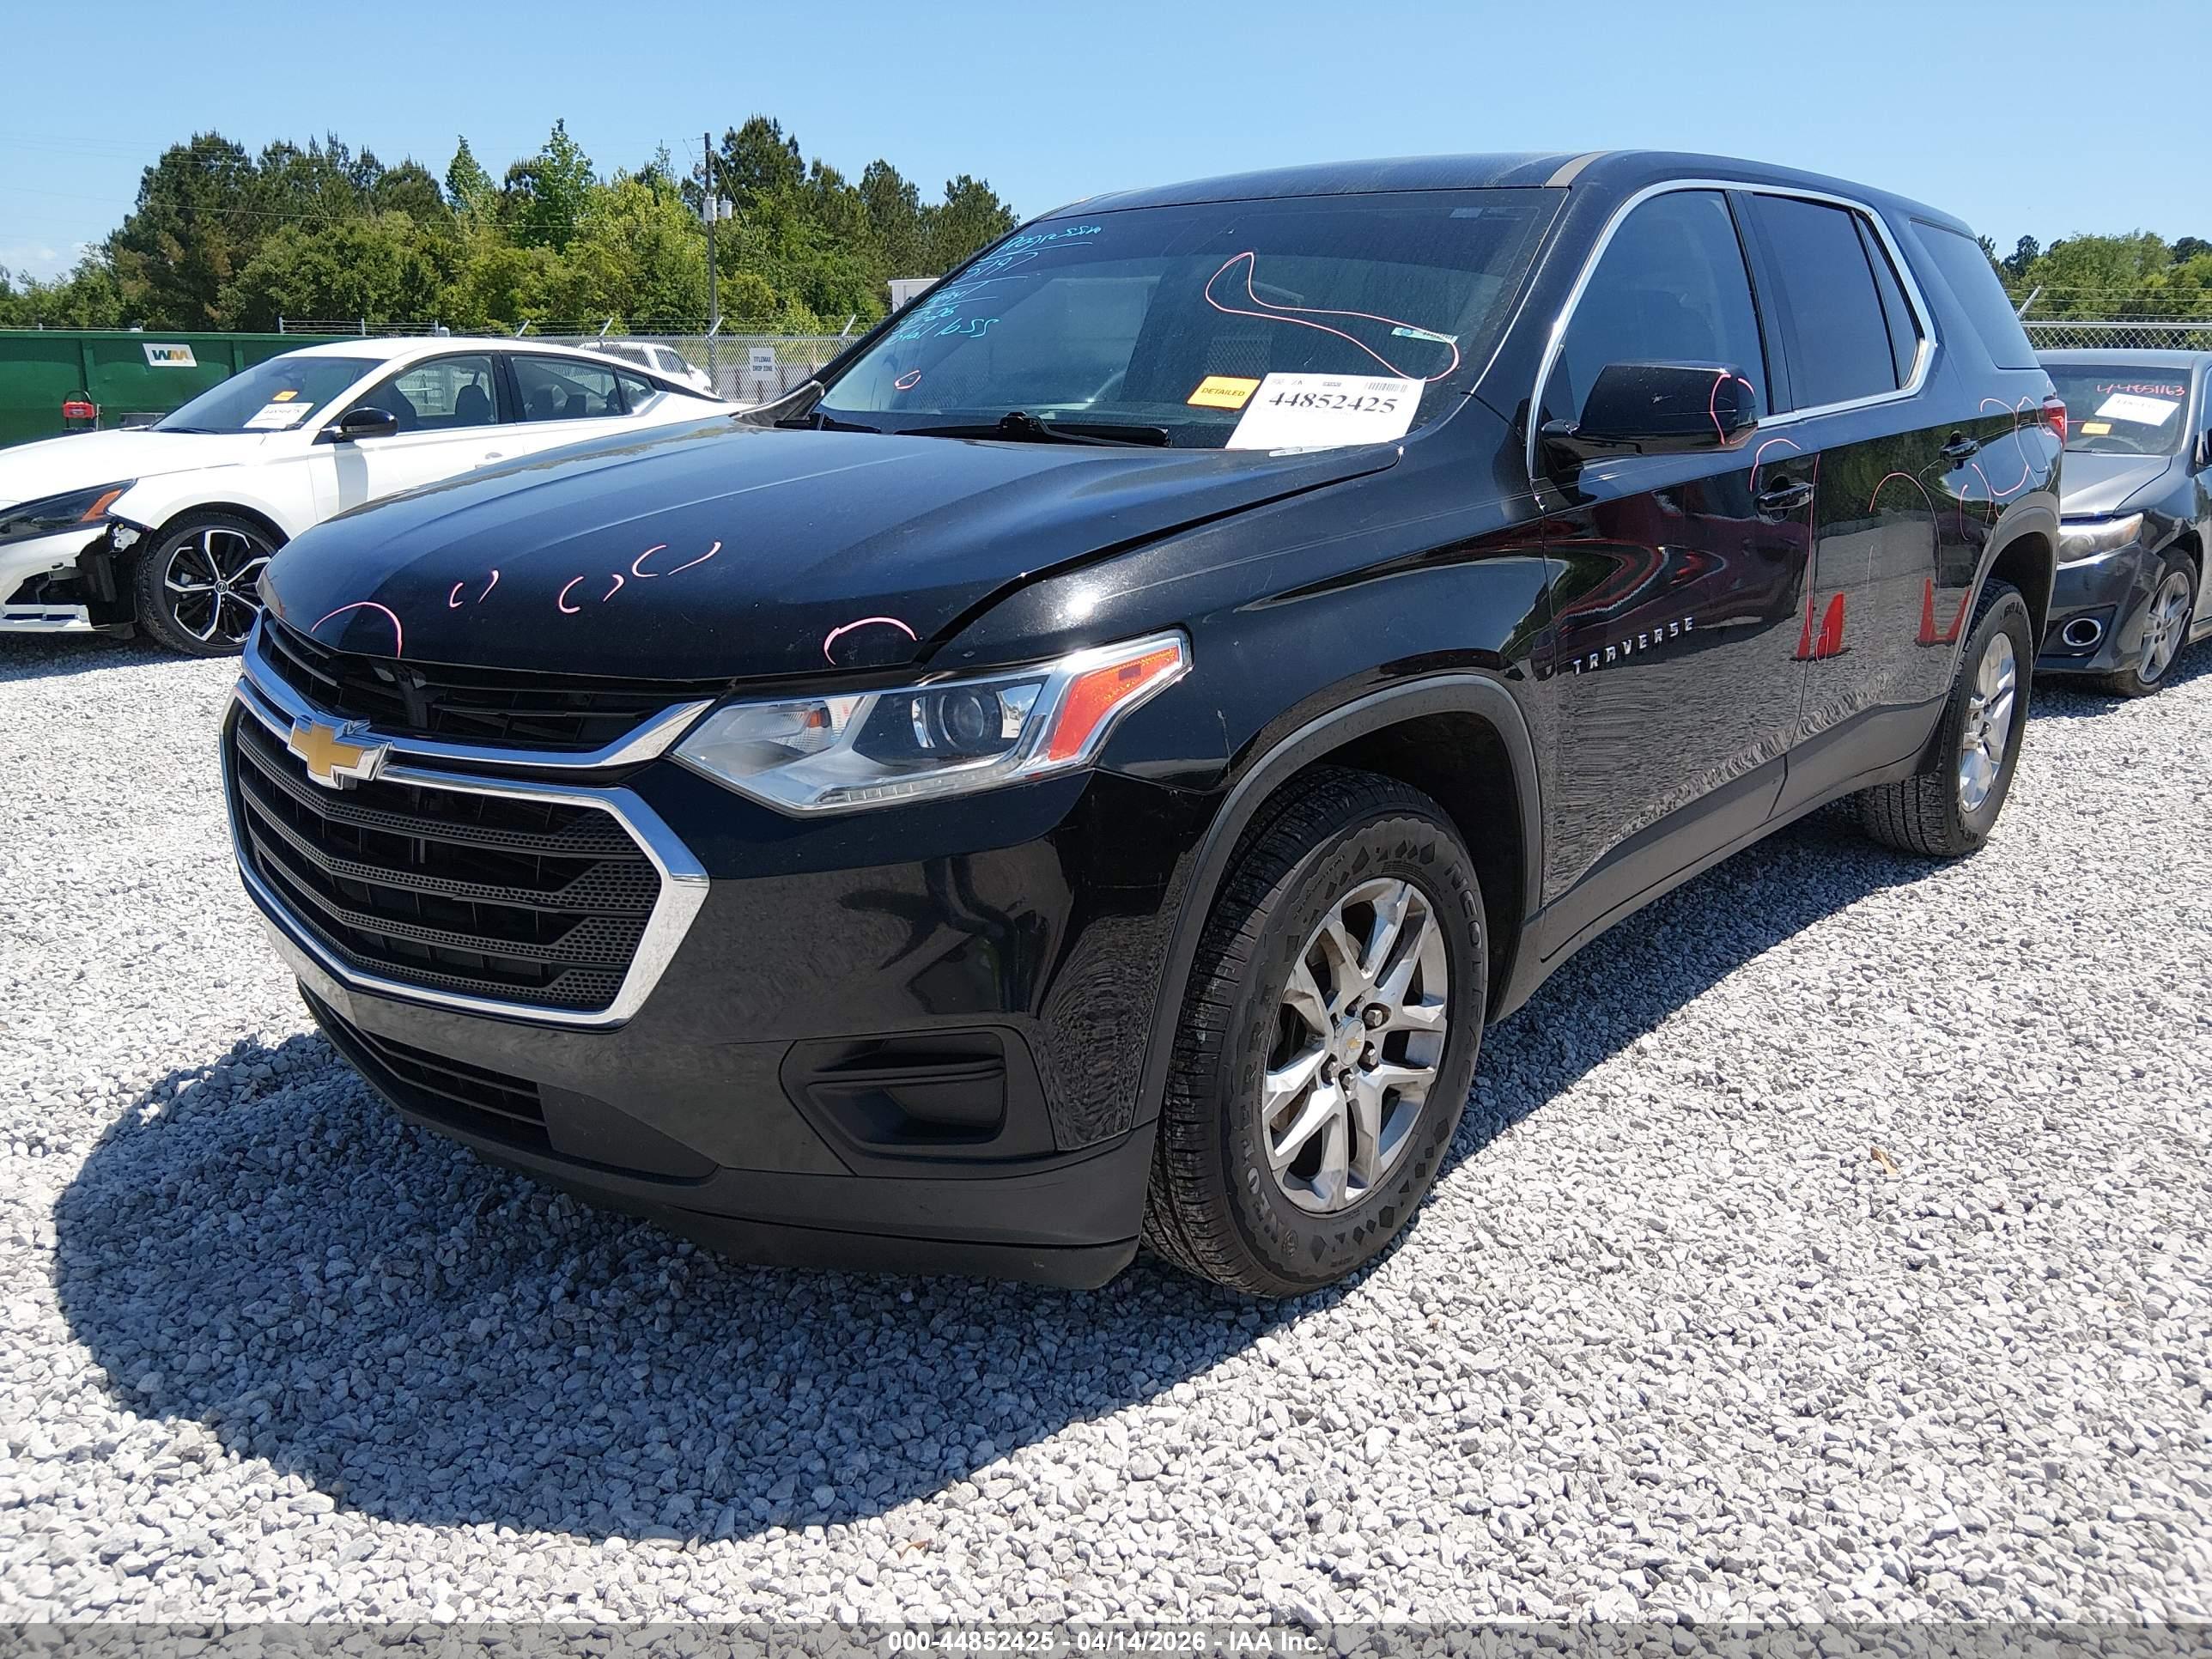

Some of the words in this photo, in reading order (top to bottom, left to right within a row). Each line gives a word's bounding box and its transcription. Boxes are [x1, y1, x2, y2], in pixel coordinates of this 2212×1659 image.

[151, 349, 188, 360] WM
[1200, 386, 1246, 398] DETAILED
[1268, 392, 1399, 415] 44852425
[1572, 617, 1694, 676] TRAVERSE
